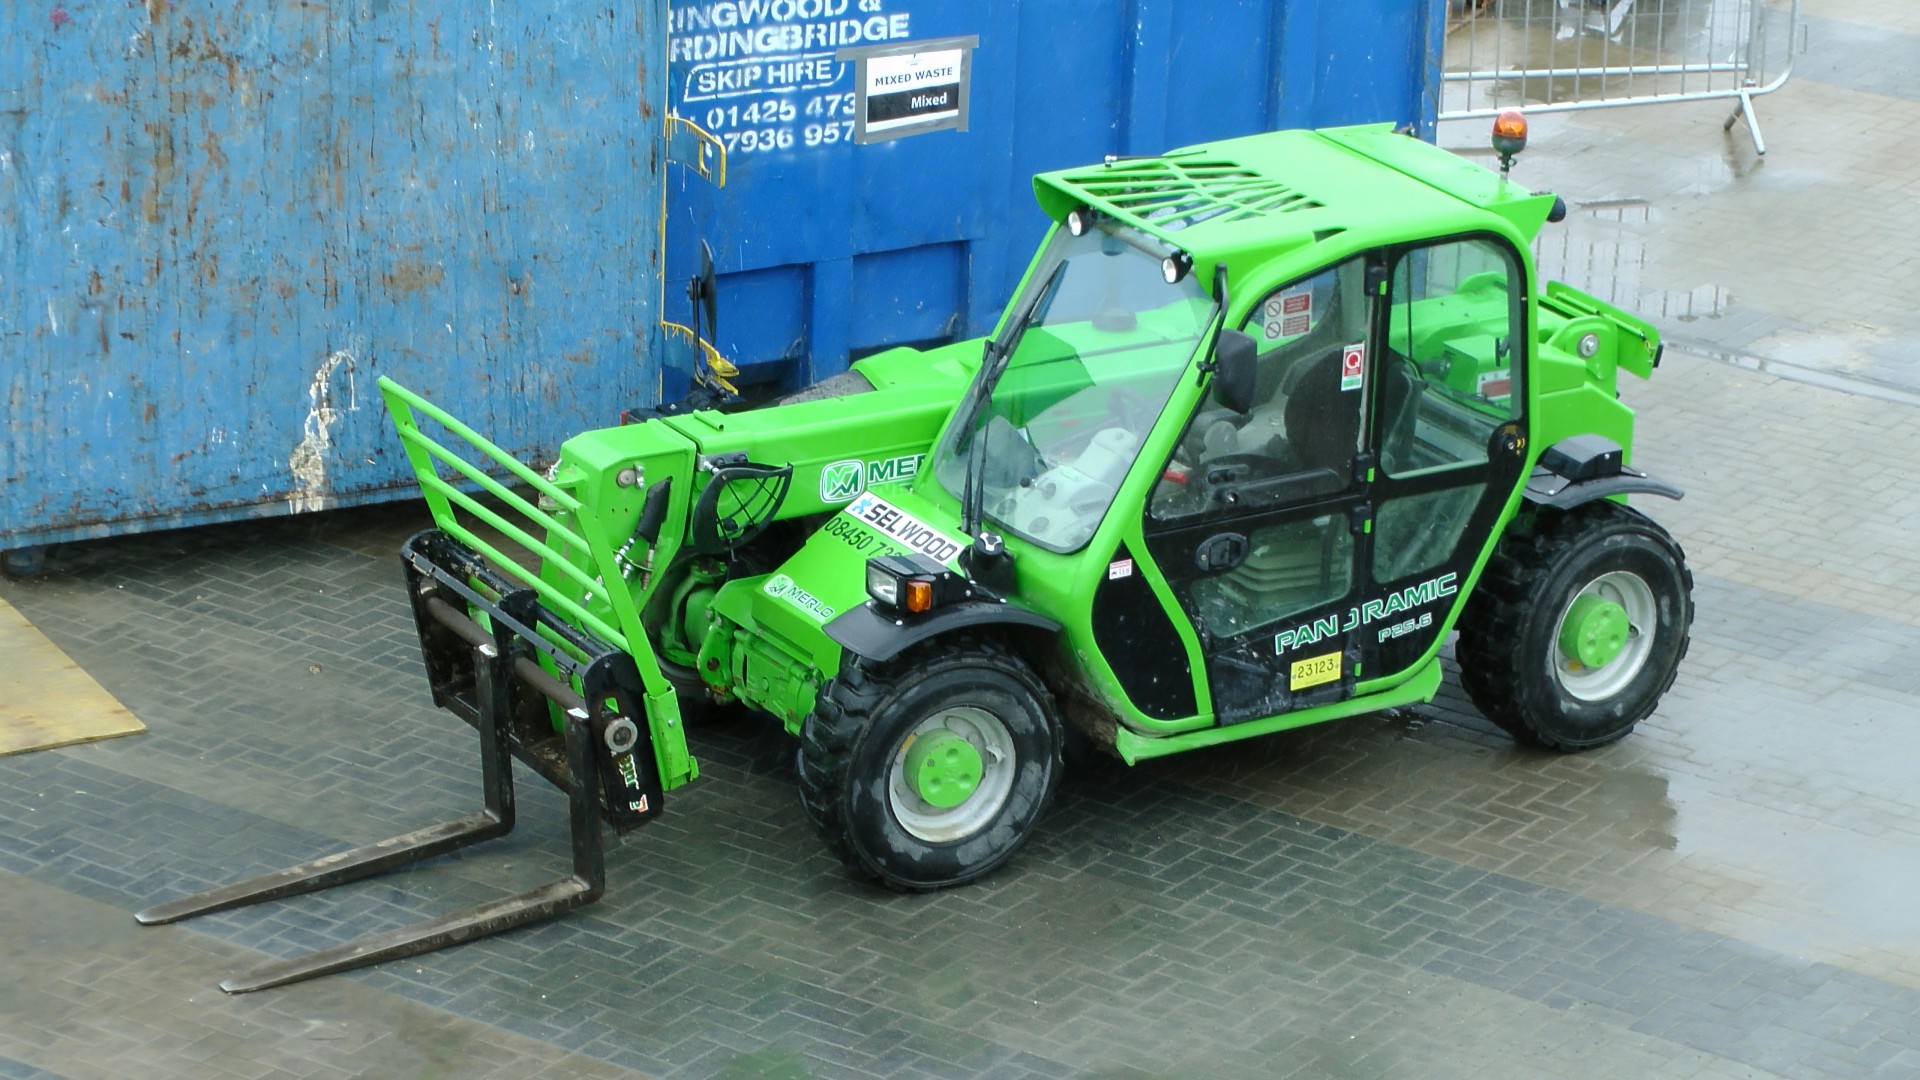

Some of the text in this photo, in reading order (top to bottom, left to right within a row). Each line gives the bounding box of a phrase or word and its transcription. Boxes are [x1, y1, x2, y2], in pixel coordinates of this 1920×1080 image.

[698, 60, 831, 93] SKIP HIRE
[875, 66, 953, 87] MIXED WASTE
[706, 99, 797, 130] 01425
[911, 92, 947, 109] Mixed
[824, 516, 874, 551] 08450
[863, 503, 957, 562] SELWOOD
[787, 586, 834, 618] MERLO
[1378, 612, 1432, 643] P25.6
[1297, 658, 1334, 679] 23123
